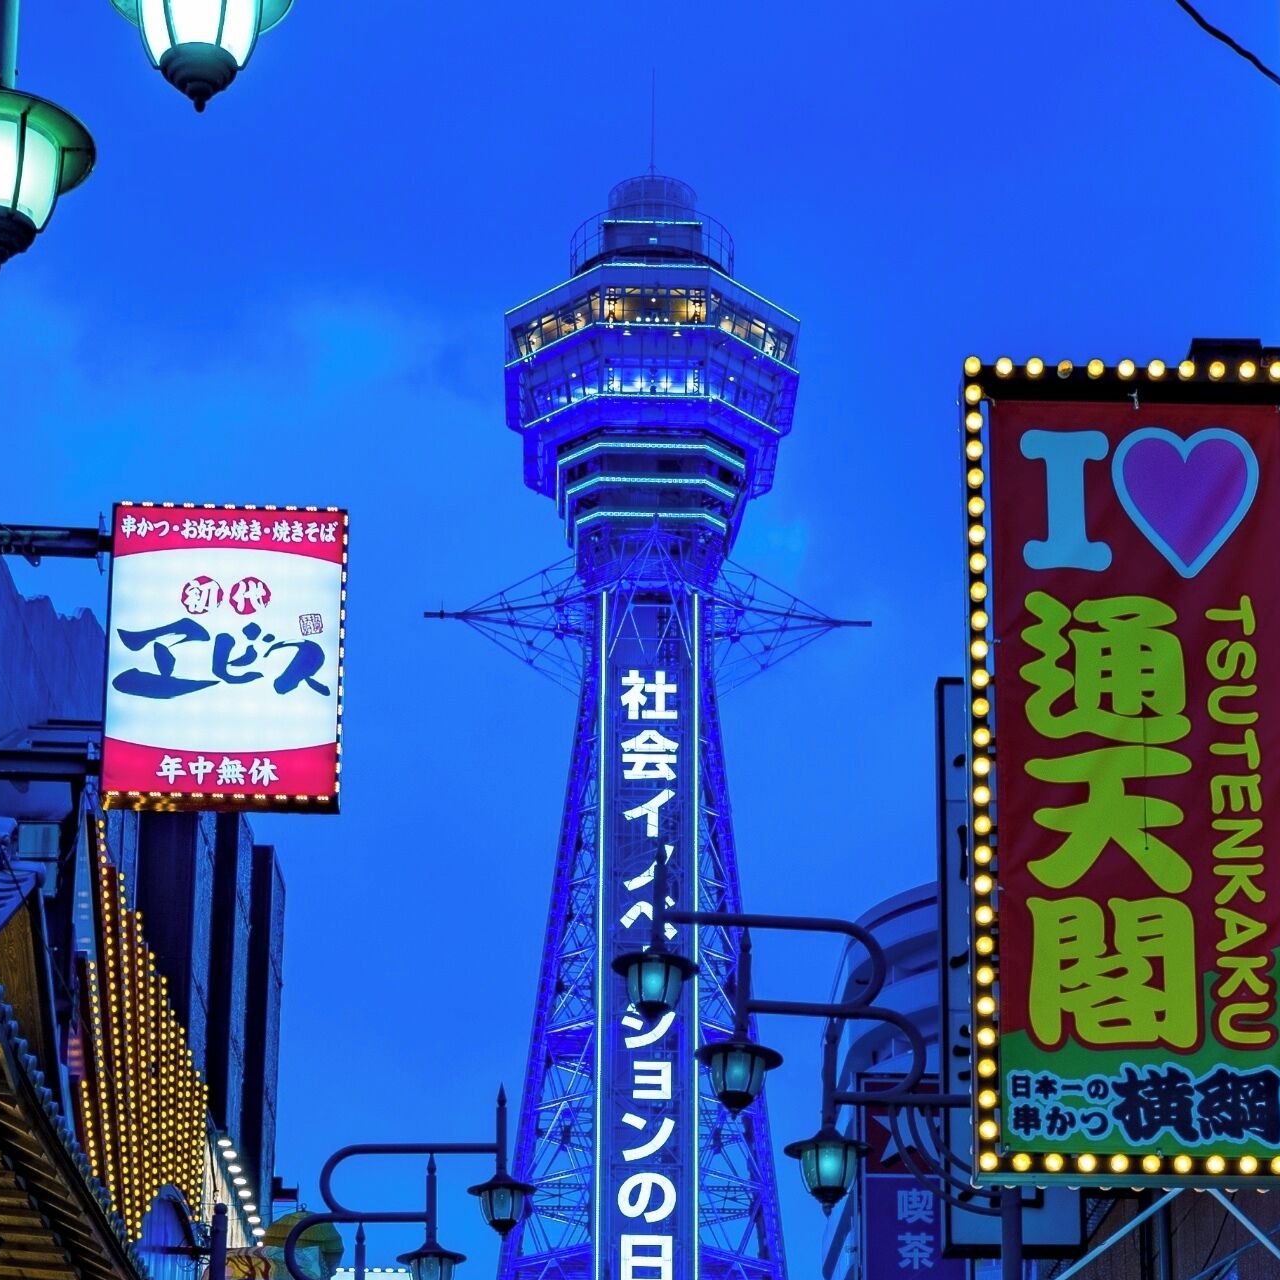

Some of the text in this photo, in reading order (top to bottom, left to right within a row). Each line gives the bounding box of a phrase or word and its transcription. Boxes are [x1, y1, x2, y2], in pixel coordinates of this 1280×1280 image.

[121, 516, 337, 545] 串かつ・お好み焼き・焼きそば
[182, 578, 272, 615] 初代
[155, 755, 279, 788] 年中無休
[1022, 591, 1204, 1050] 通天閣
[1206, 595, 1275, 1047] TSUTENKAKU
[1010, 1075, 1110, 1101] 日本一の
[1012, 1103, 1110, 1137] 串かつ
[896, 1188, 935, 1270] 喫茶
